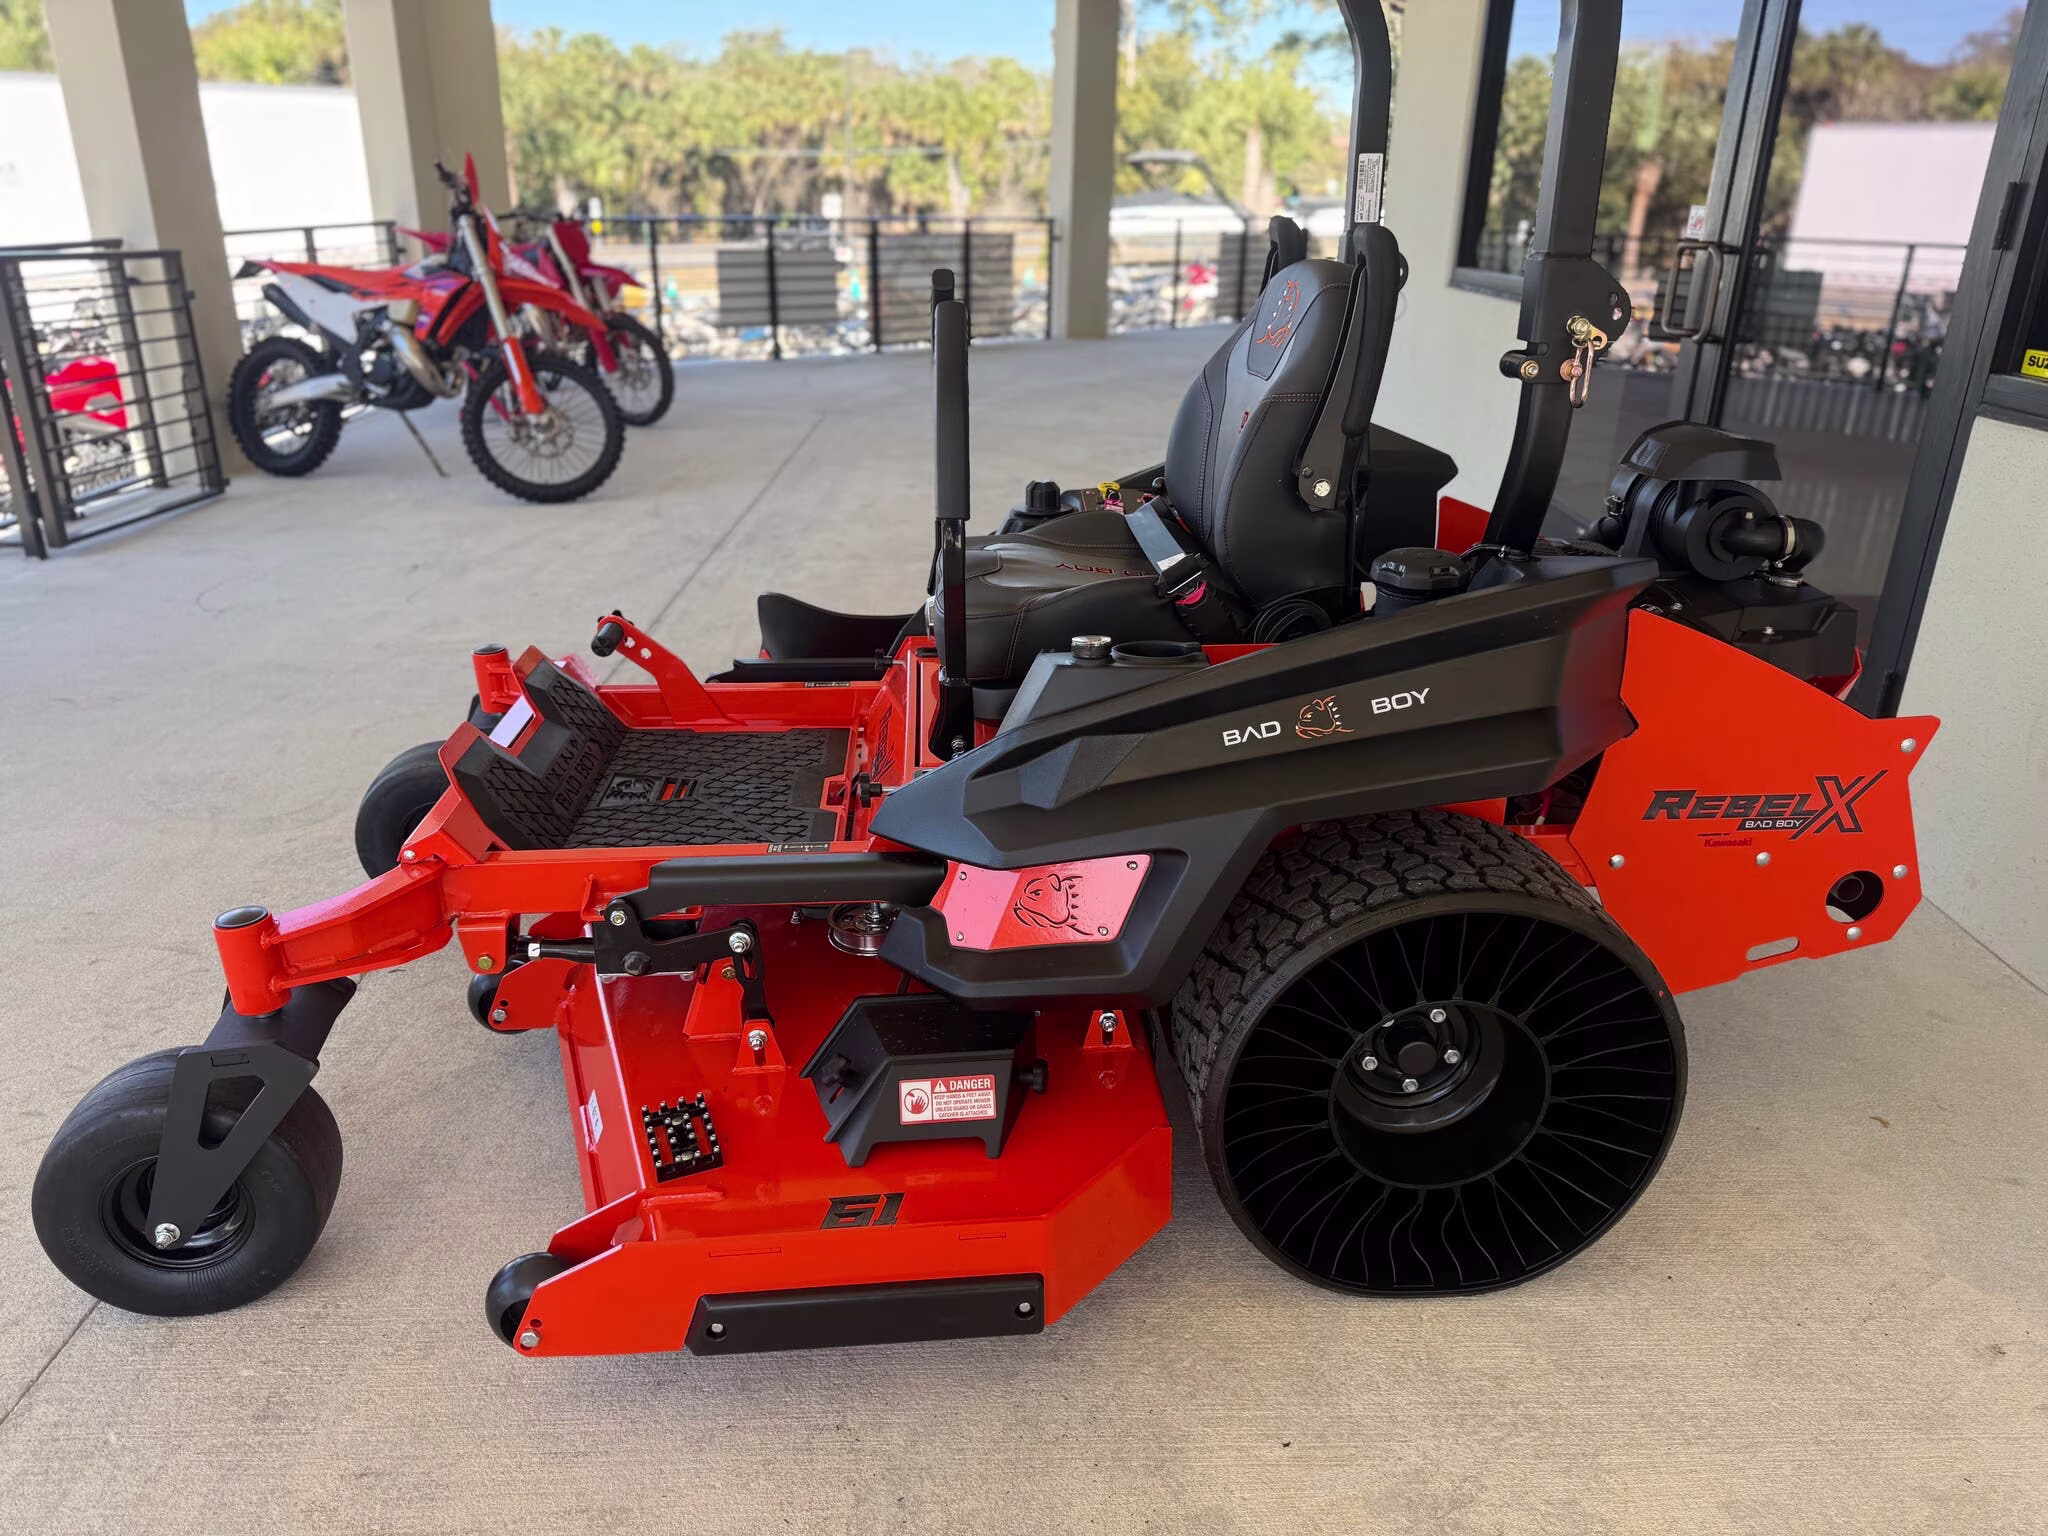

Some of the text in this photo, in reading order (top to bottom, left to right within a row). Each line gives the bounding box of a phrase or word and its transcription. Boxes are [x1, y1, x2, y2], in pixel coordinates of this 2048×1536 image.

[1222, 687, 1431, 747] BAD BOY
[554, 745, 601, 811] BAD BOY
[1745, 818, 1803, 828] BAD BOY
[1703, 837, 1753, 848] Kawasaki
[1270, 972, 1289, 989] USE
[950, 1078, 991, 1091] DANGER
[820, 1191, 906, 1231] 61
